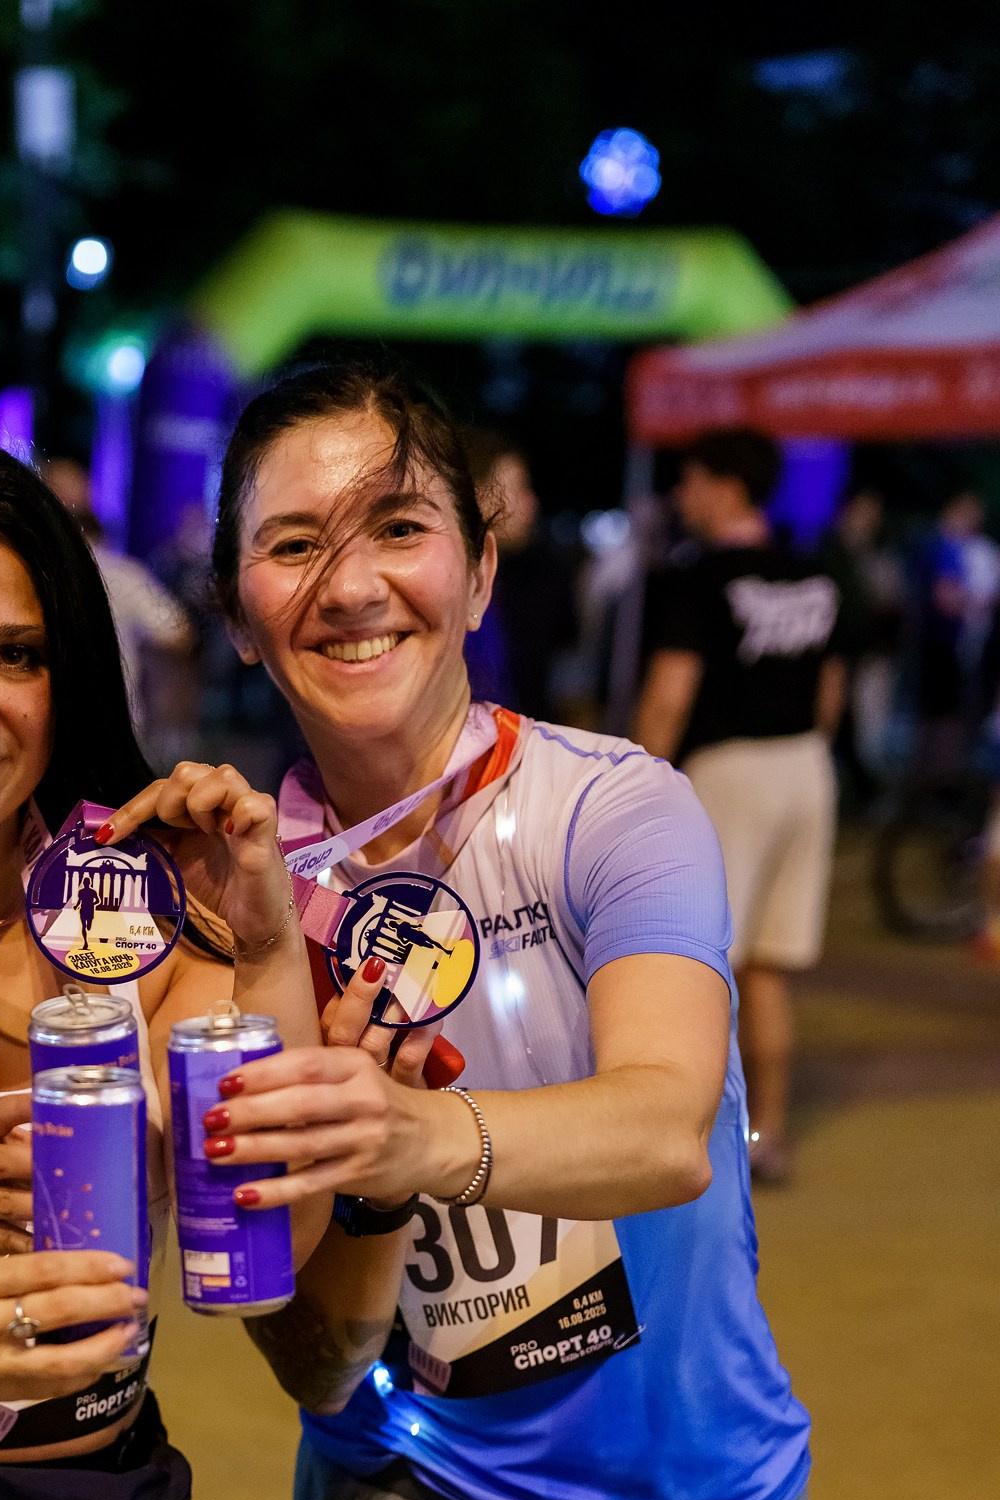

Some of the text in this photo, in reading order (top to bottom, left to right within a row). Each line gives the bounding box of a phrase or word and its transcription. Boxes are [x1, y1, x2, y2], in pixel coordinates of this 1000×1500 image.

[68, 952, 97, 964] ЗАБЕГ
[110, 953, 134, 965] НОЧЬ
[422, 1284, 531, 1329] ВИКТОРИЯ
[510, 1340, 538, 1357] PRO
[513, 1324, 613, 1371] СПОРТ 40
[75, 1393, 98, 1406] PRO
[75, 1390, 124, 1422] СПОРТ
